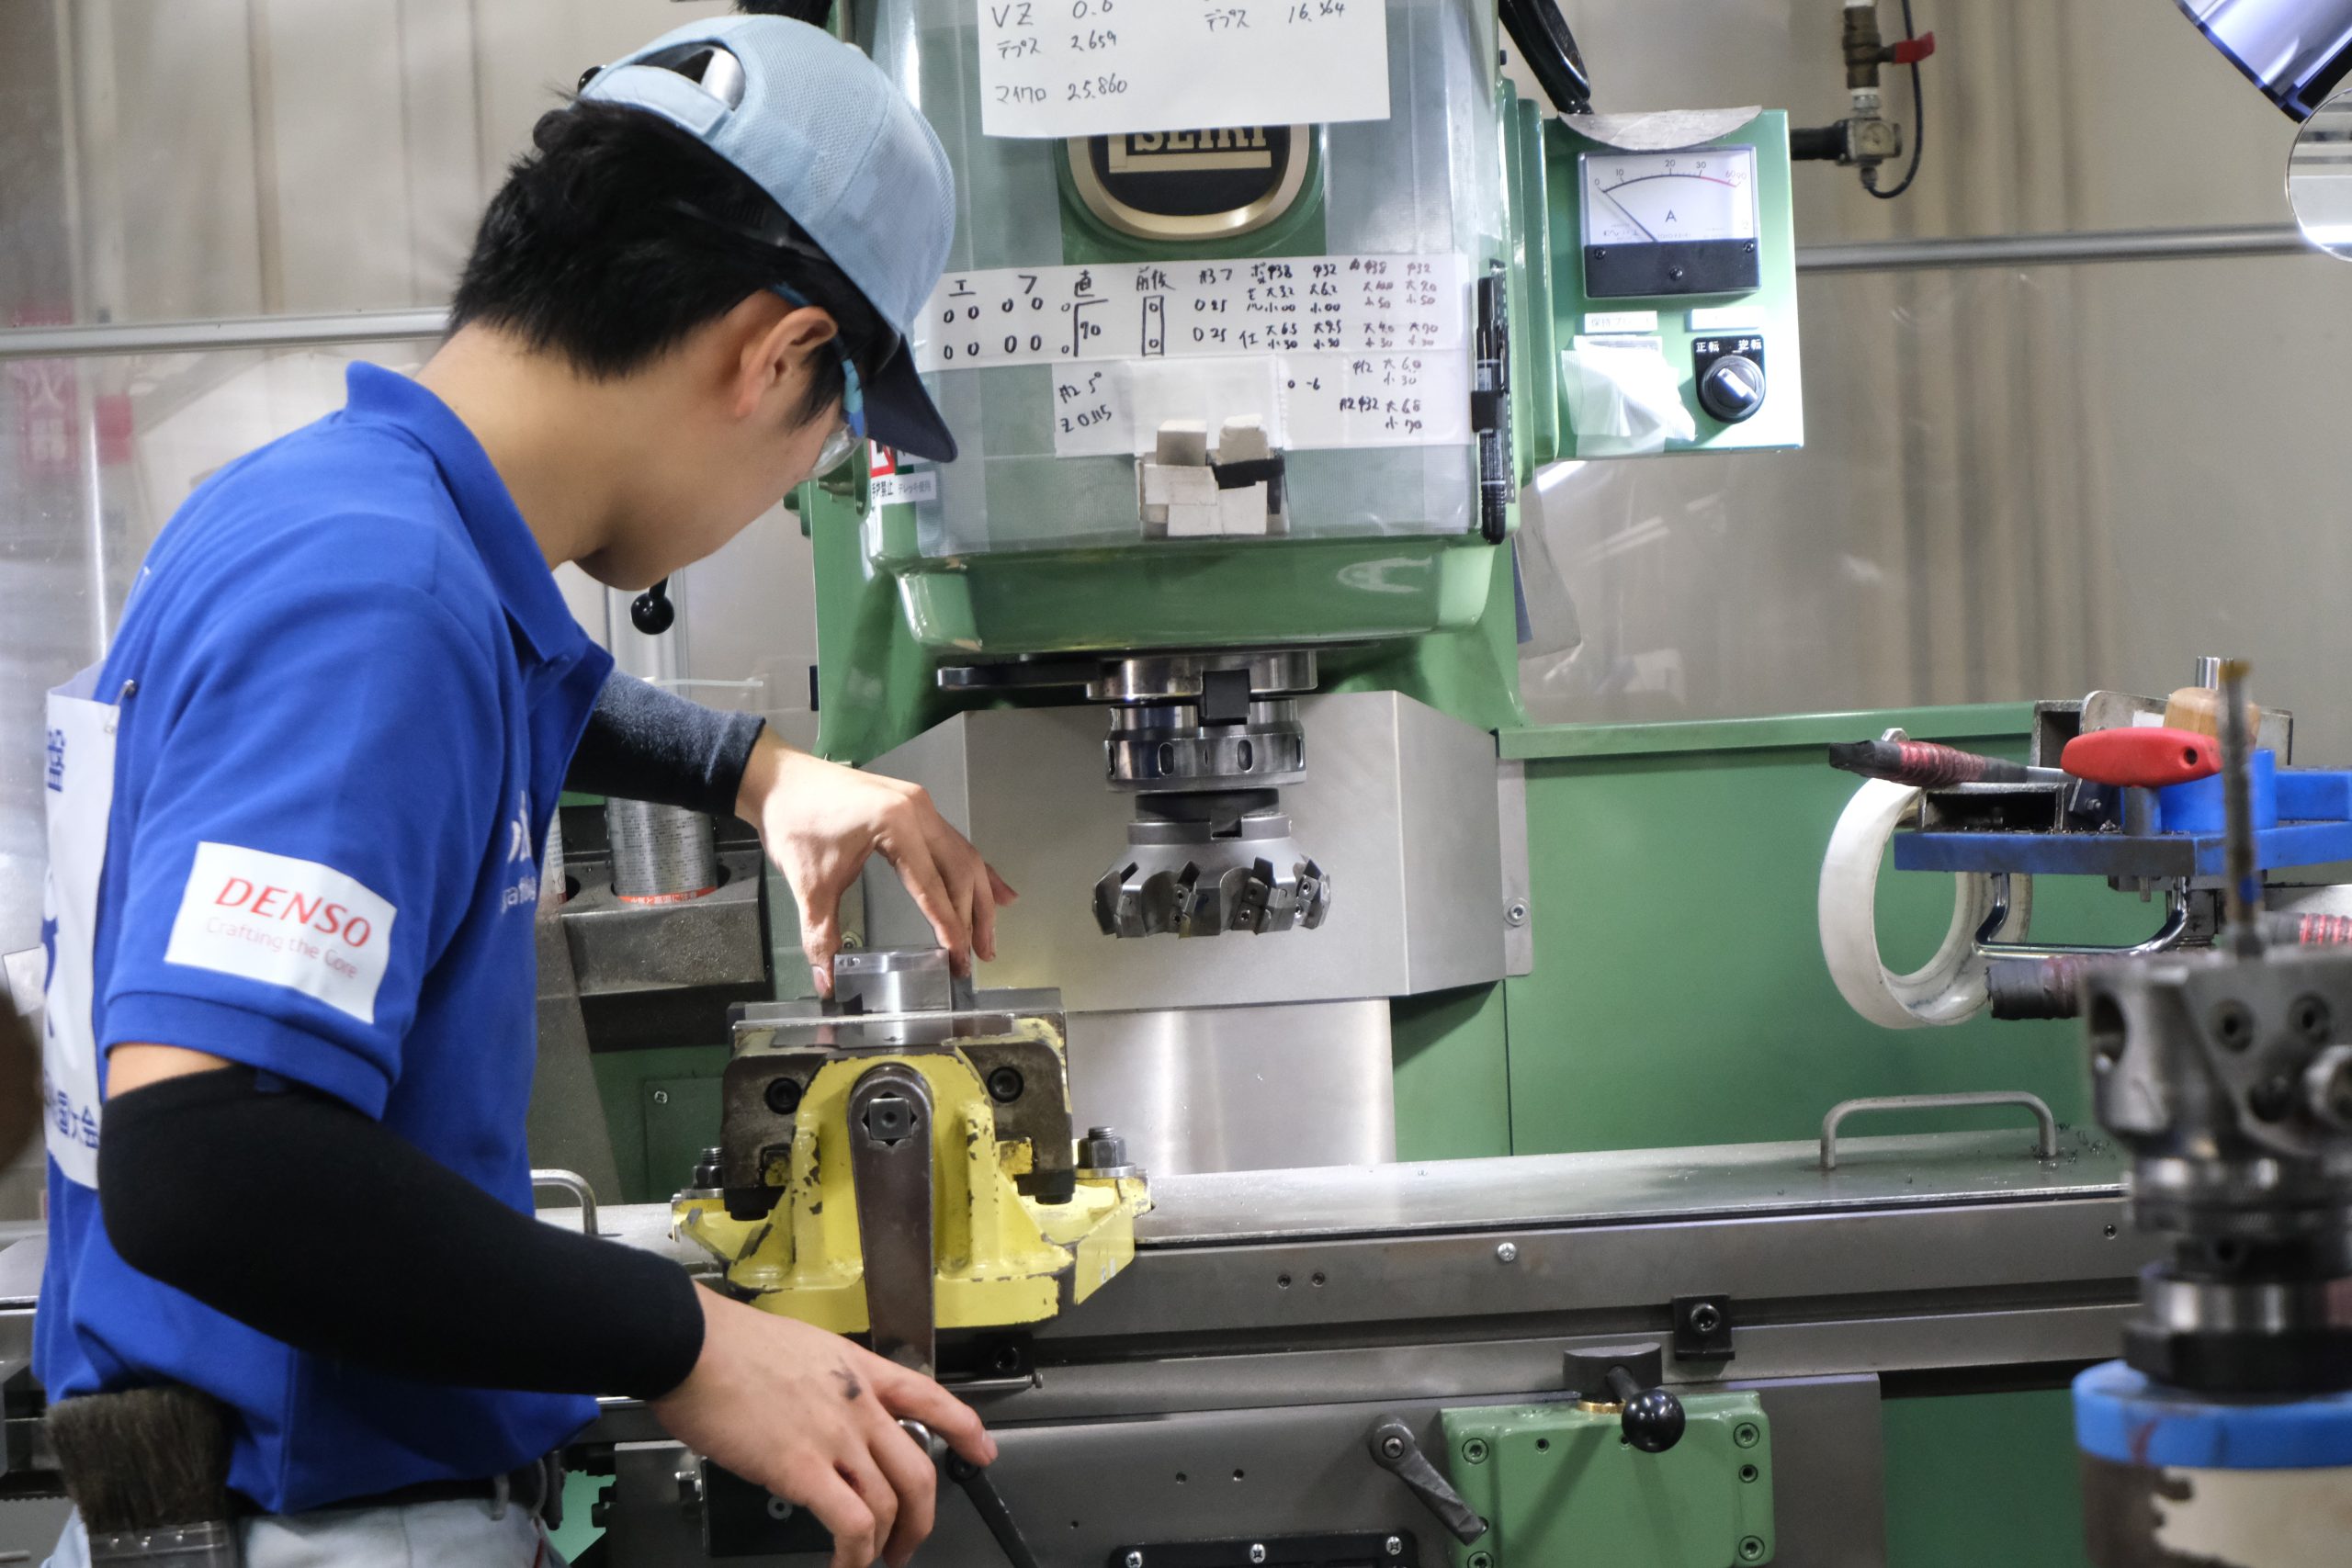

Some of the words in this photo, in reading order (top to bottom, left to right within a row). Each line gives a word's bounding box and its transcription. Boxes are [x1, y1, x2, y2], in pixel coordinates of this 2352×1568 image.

[1665, 159, 1676, 167] 20
[1696, 161, 1706, 169] 30
[1665, 209, 1677, 222] A
[1696, 340, 1720, 353] 正転
[1736, 338, 1762, 353] 逆転
[215, 877, 371, 948] DENSO
[206, 917, 284, 953] Crafting
[288, 937, 319, 960] the
[324, 949, 358, 979] Core
